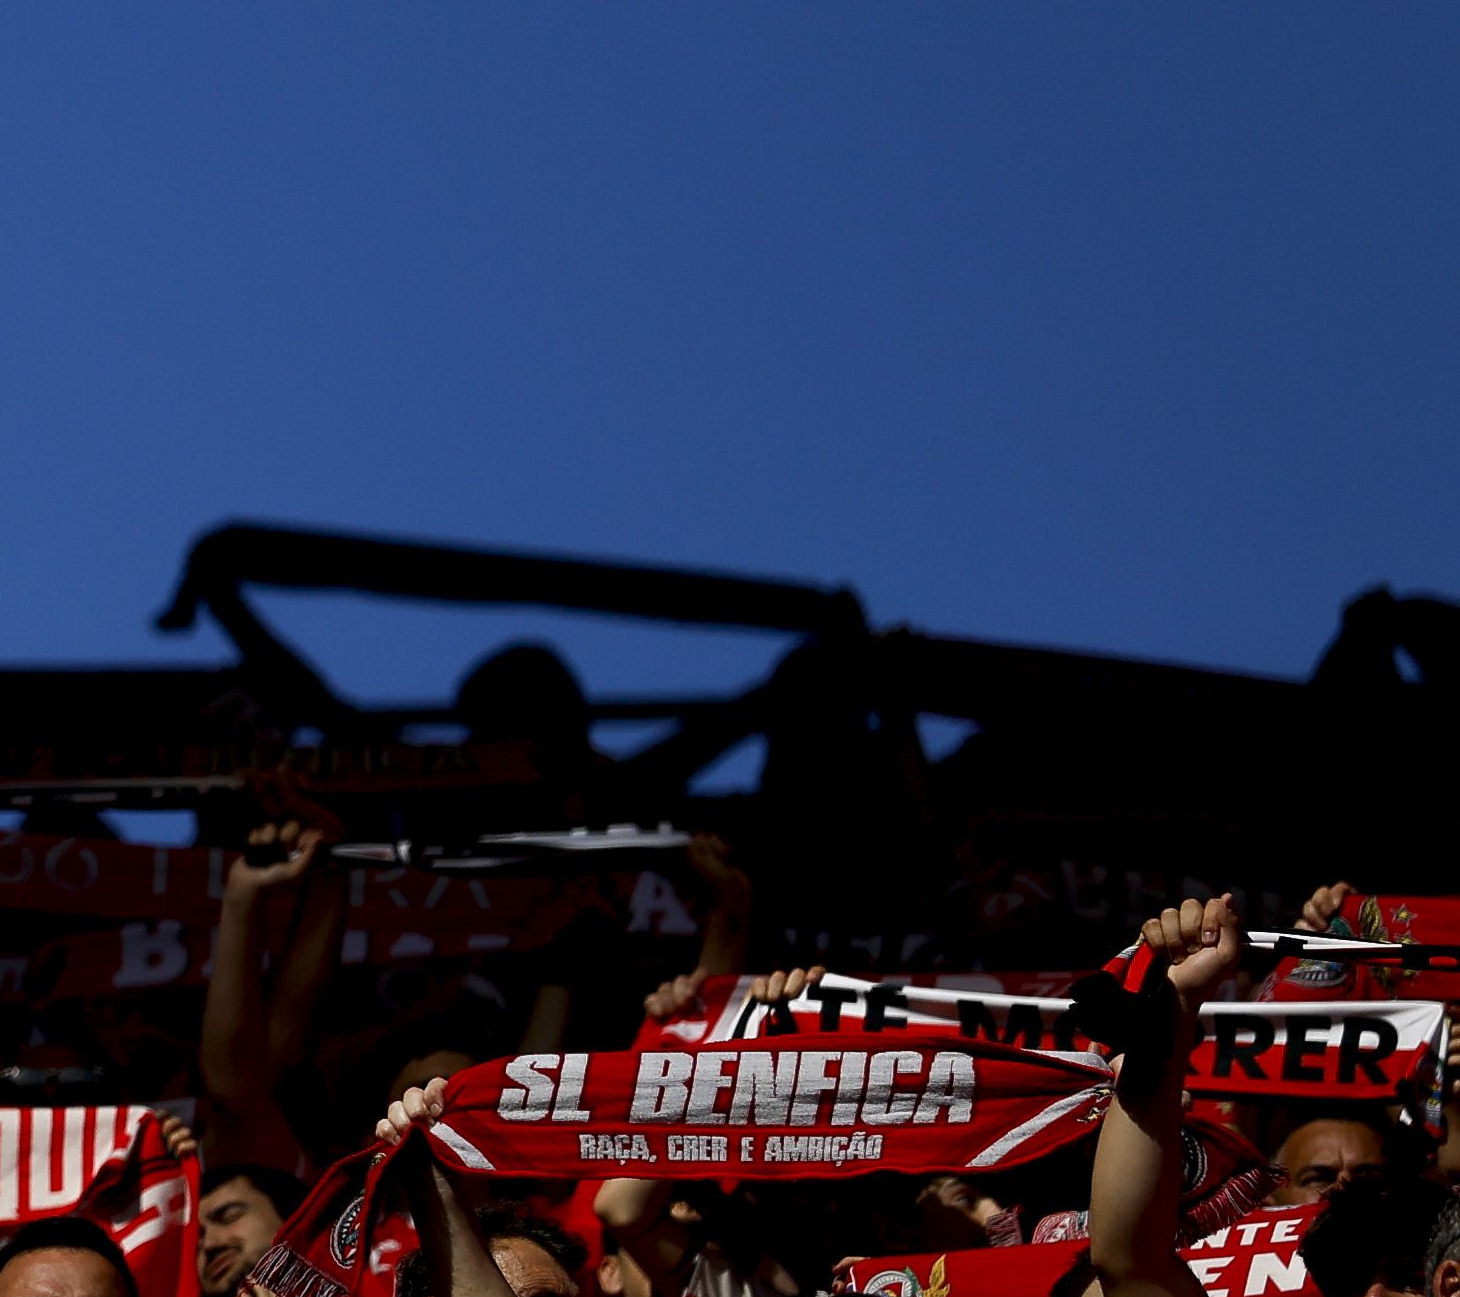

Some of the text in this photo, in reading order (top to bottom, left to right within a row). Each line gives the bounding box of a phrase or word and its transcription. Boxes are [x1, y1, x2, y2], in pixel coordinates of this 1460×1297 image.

[497, 1050, 976, 1126] SL BENFICA
[667, 1134, 728, 1163] CRER
[740, 1134, 755, 1162] E
[763, 1131, 884, 1167] AMBIÇÃO
